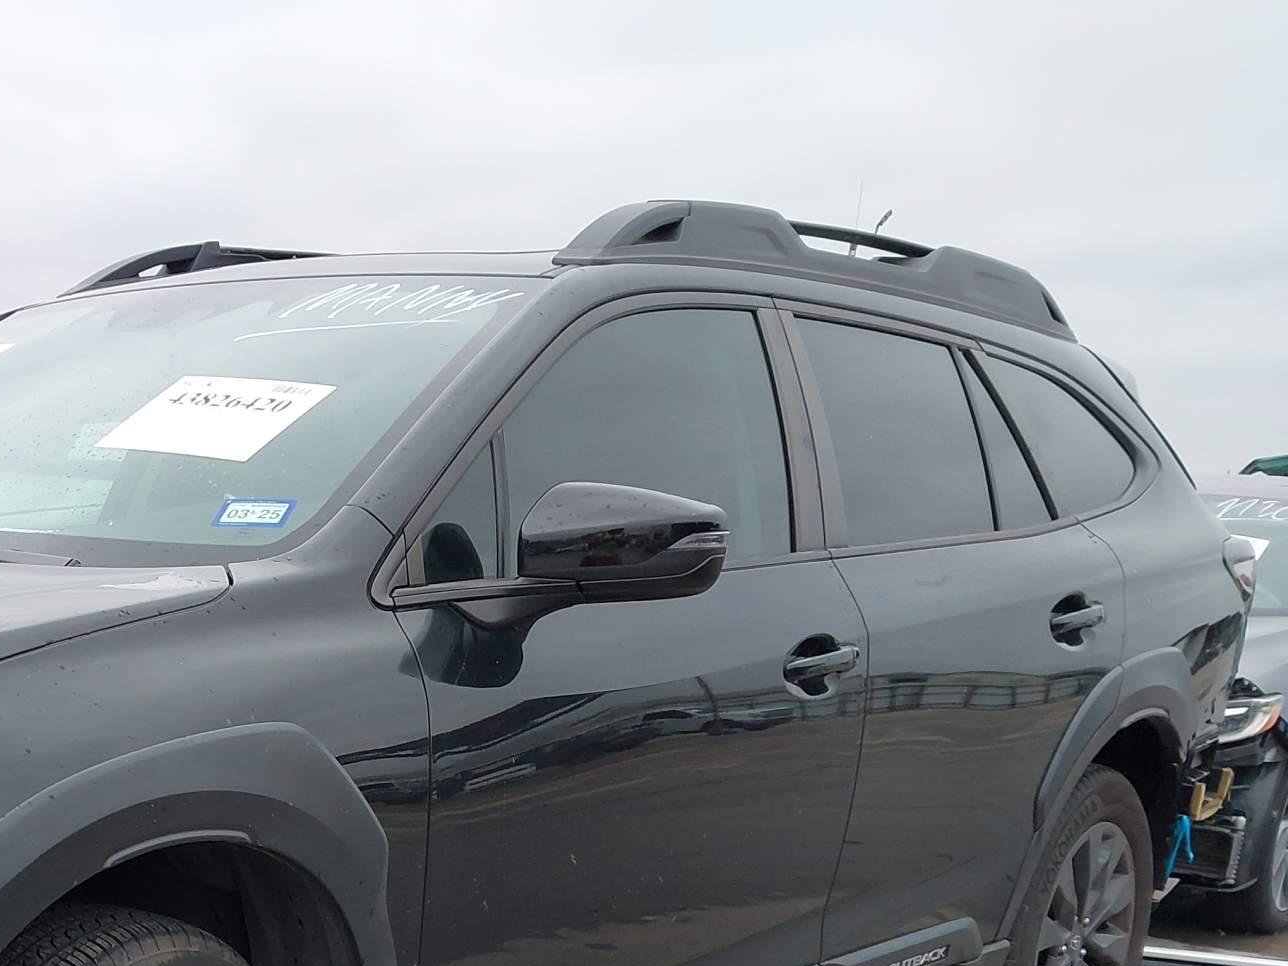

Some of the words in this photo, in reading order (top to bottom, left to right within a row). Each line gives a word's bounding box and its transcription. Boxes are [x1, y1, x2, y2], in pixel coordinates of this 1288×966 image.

[168, 392, 293, 413] 43826420
[226, 508, 250, 519] 03
[257, 509, 283, 520] 25
